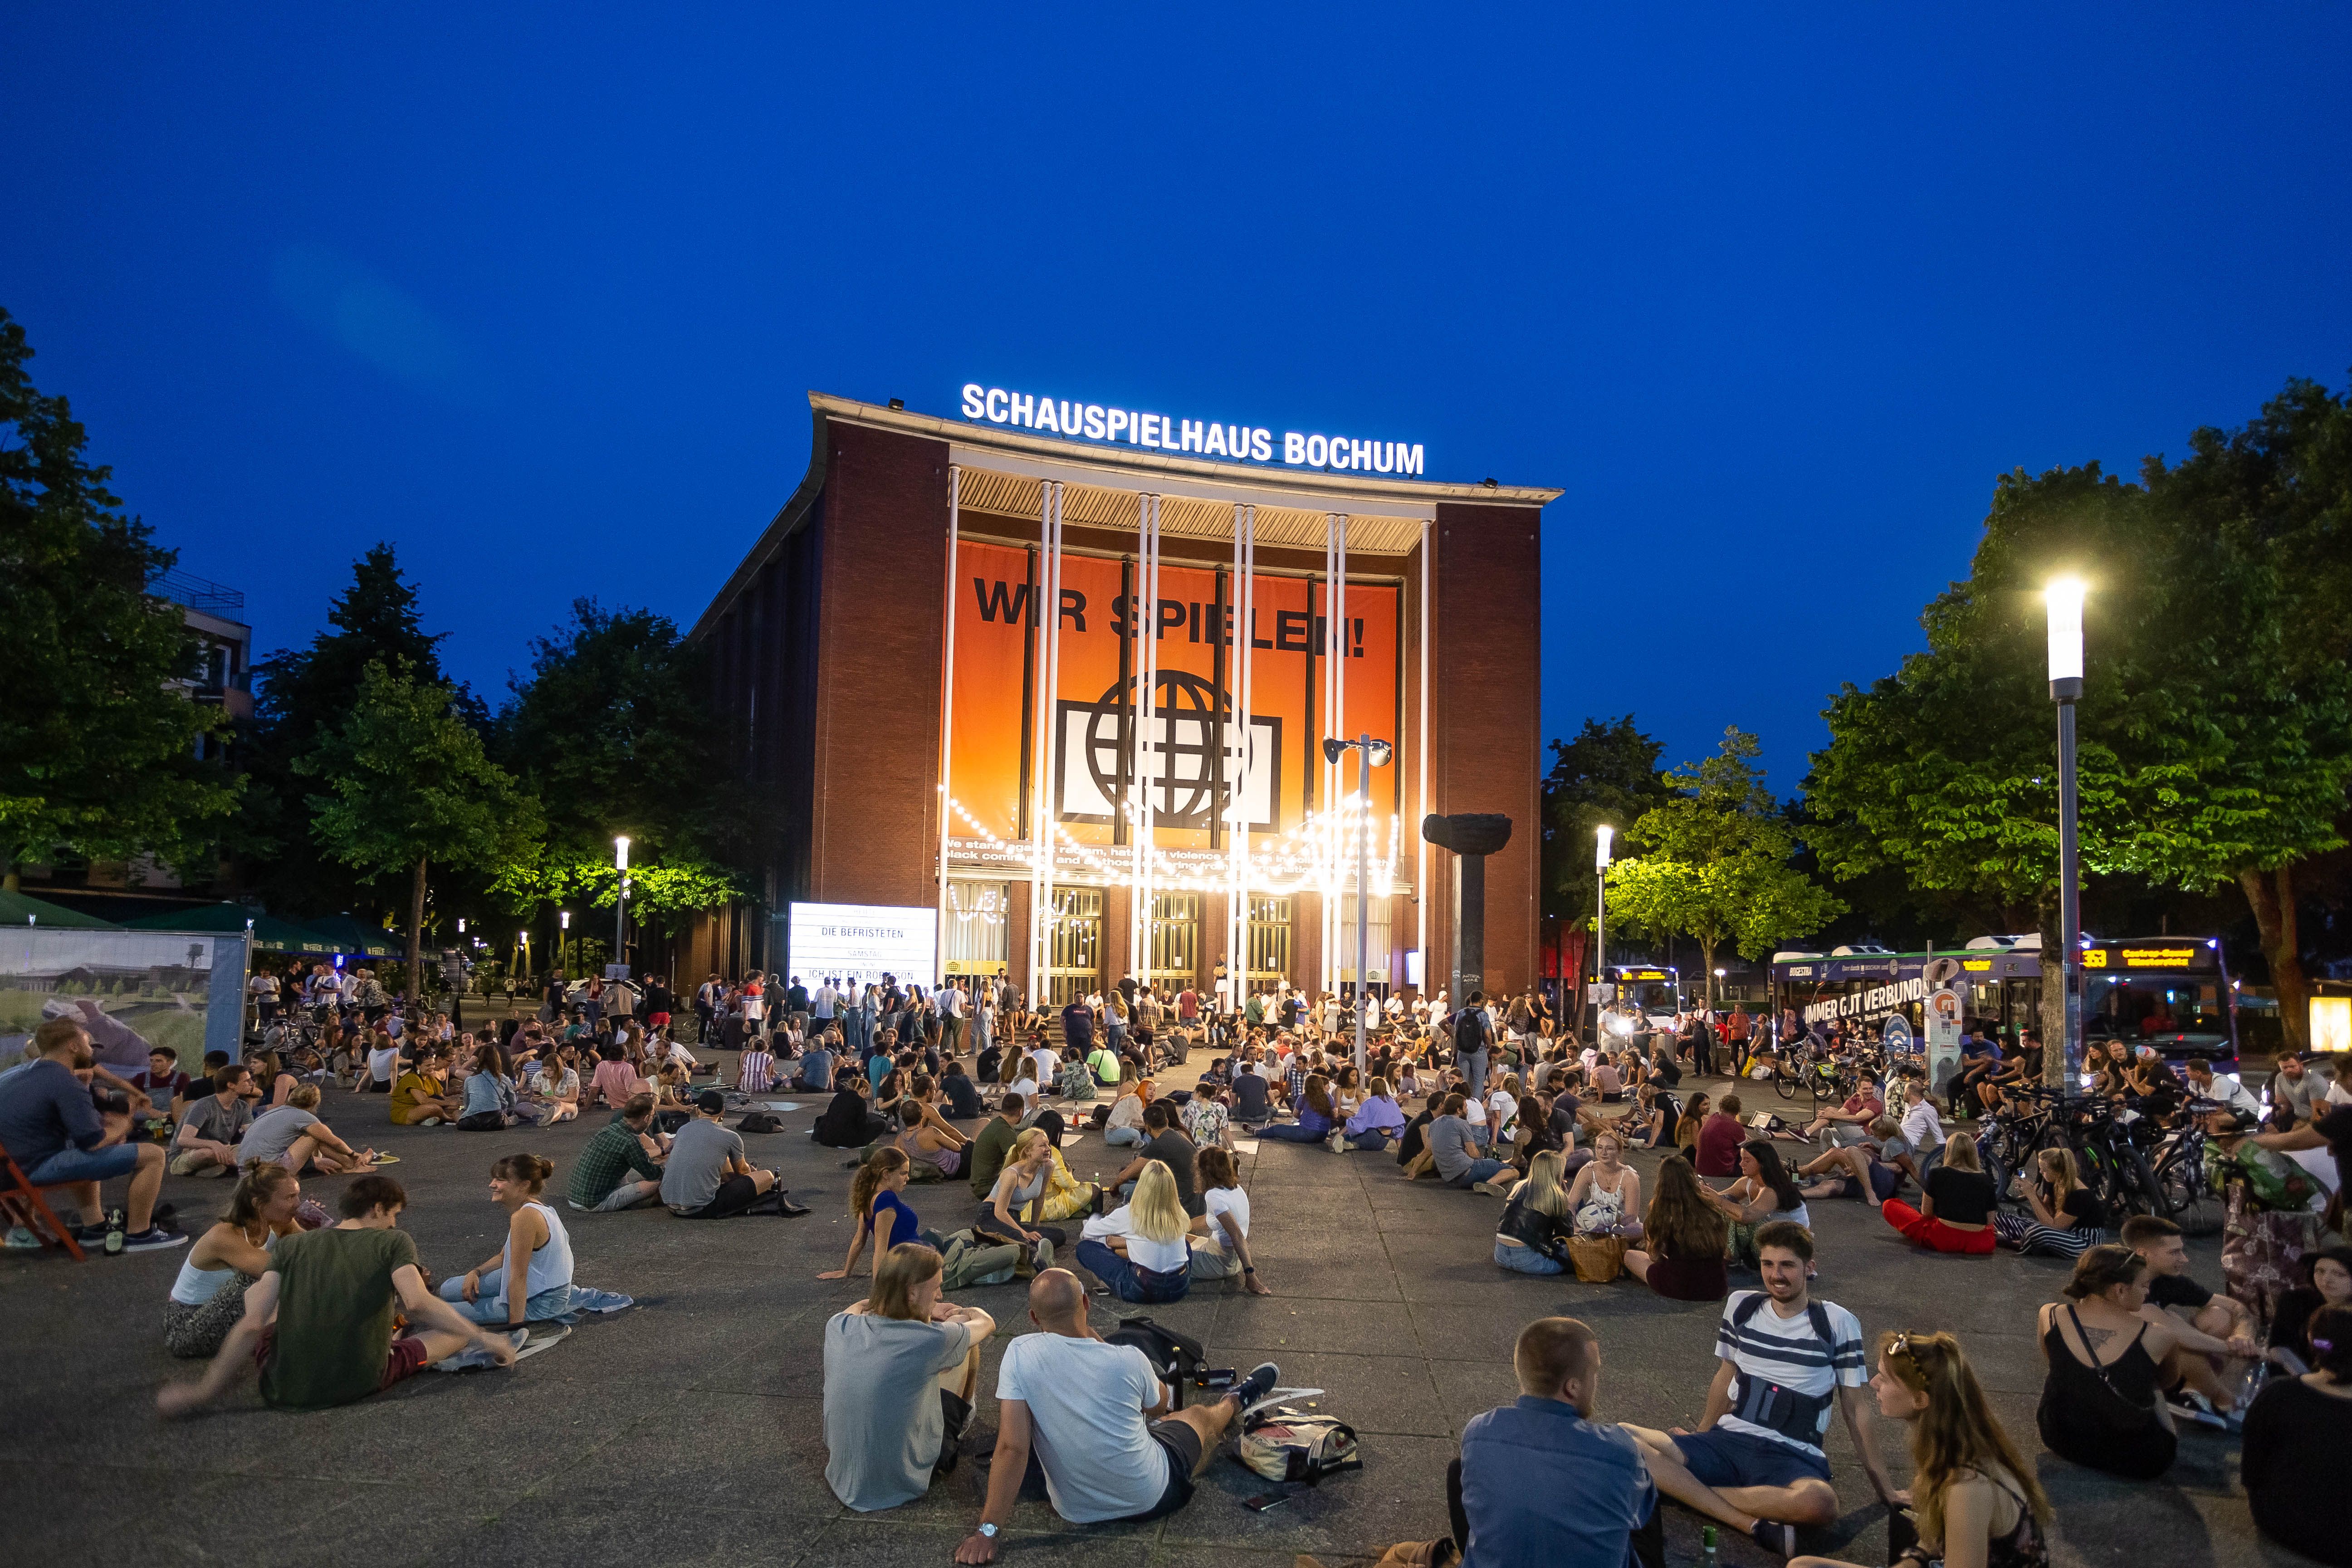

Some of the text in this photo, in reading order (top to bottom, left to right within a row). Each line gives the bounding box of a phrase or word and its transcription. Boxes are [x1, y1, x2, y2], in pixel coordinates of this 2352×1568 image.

[961, 383, 1424, 475] SCHAUSPIELHAUS BOCHUM
[1169, 850, 1222, 860] violence
[1056, 856, 1081, 865] and
[821, 927, 904, 938] DIE BEFRISTETEN
[848, 950, 882, 958] SAMSTAG
[2082, 949, 2107, 967] 353
[809, 970, 913, 980] ICH IST EIN ROBNSON
[1790, 967, 1812, 976] BOGESTRA
[1805, 999, 1838, 1024] IMMER
[1864, 977, 1928, 1011] VERBUND
